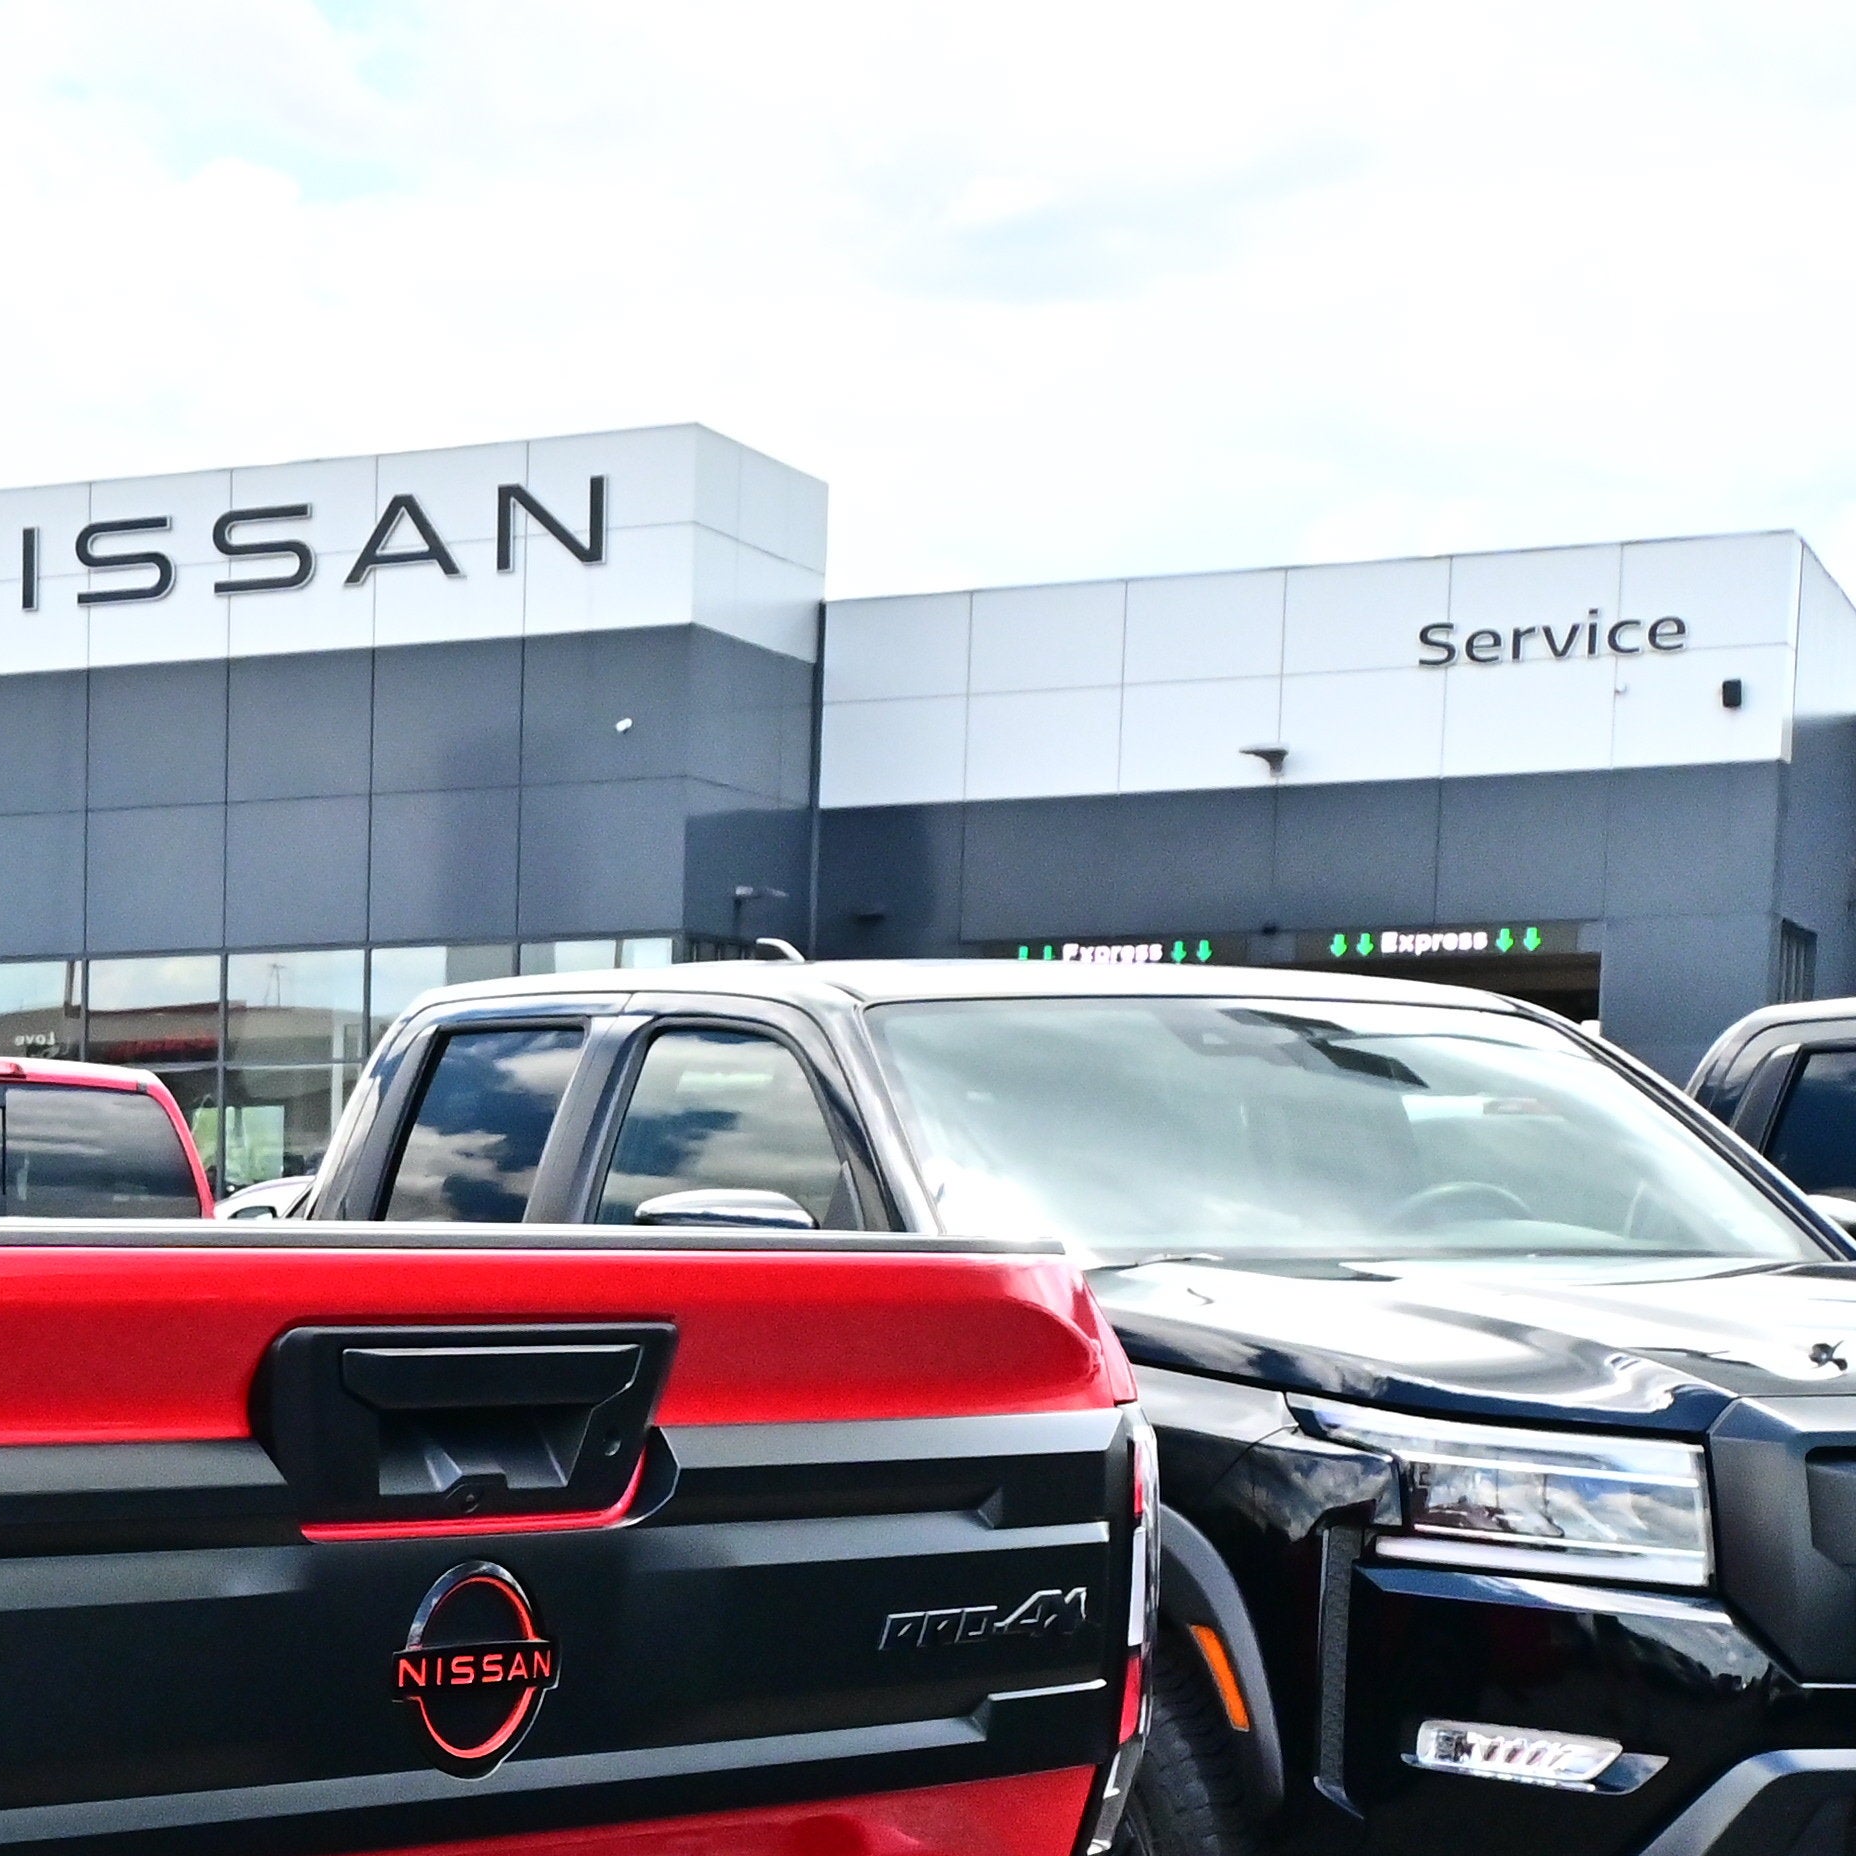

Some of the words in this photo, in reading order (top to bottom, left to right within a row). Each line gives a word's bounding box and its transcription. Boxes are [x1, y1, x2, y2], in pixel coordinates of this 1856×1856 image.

[1418, 608, 1687, 667] Service
[1062, 943, 1165, 964] Express
[1380, 929, 1489, 957] Express
[398, 1650, 552, 1688] NISSAN
